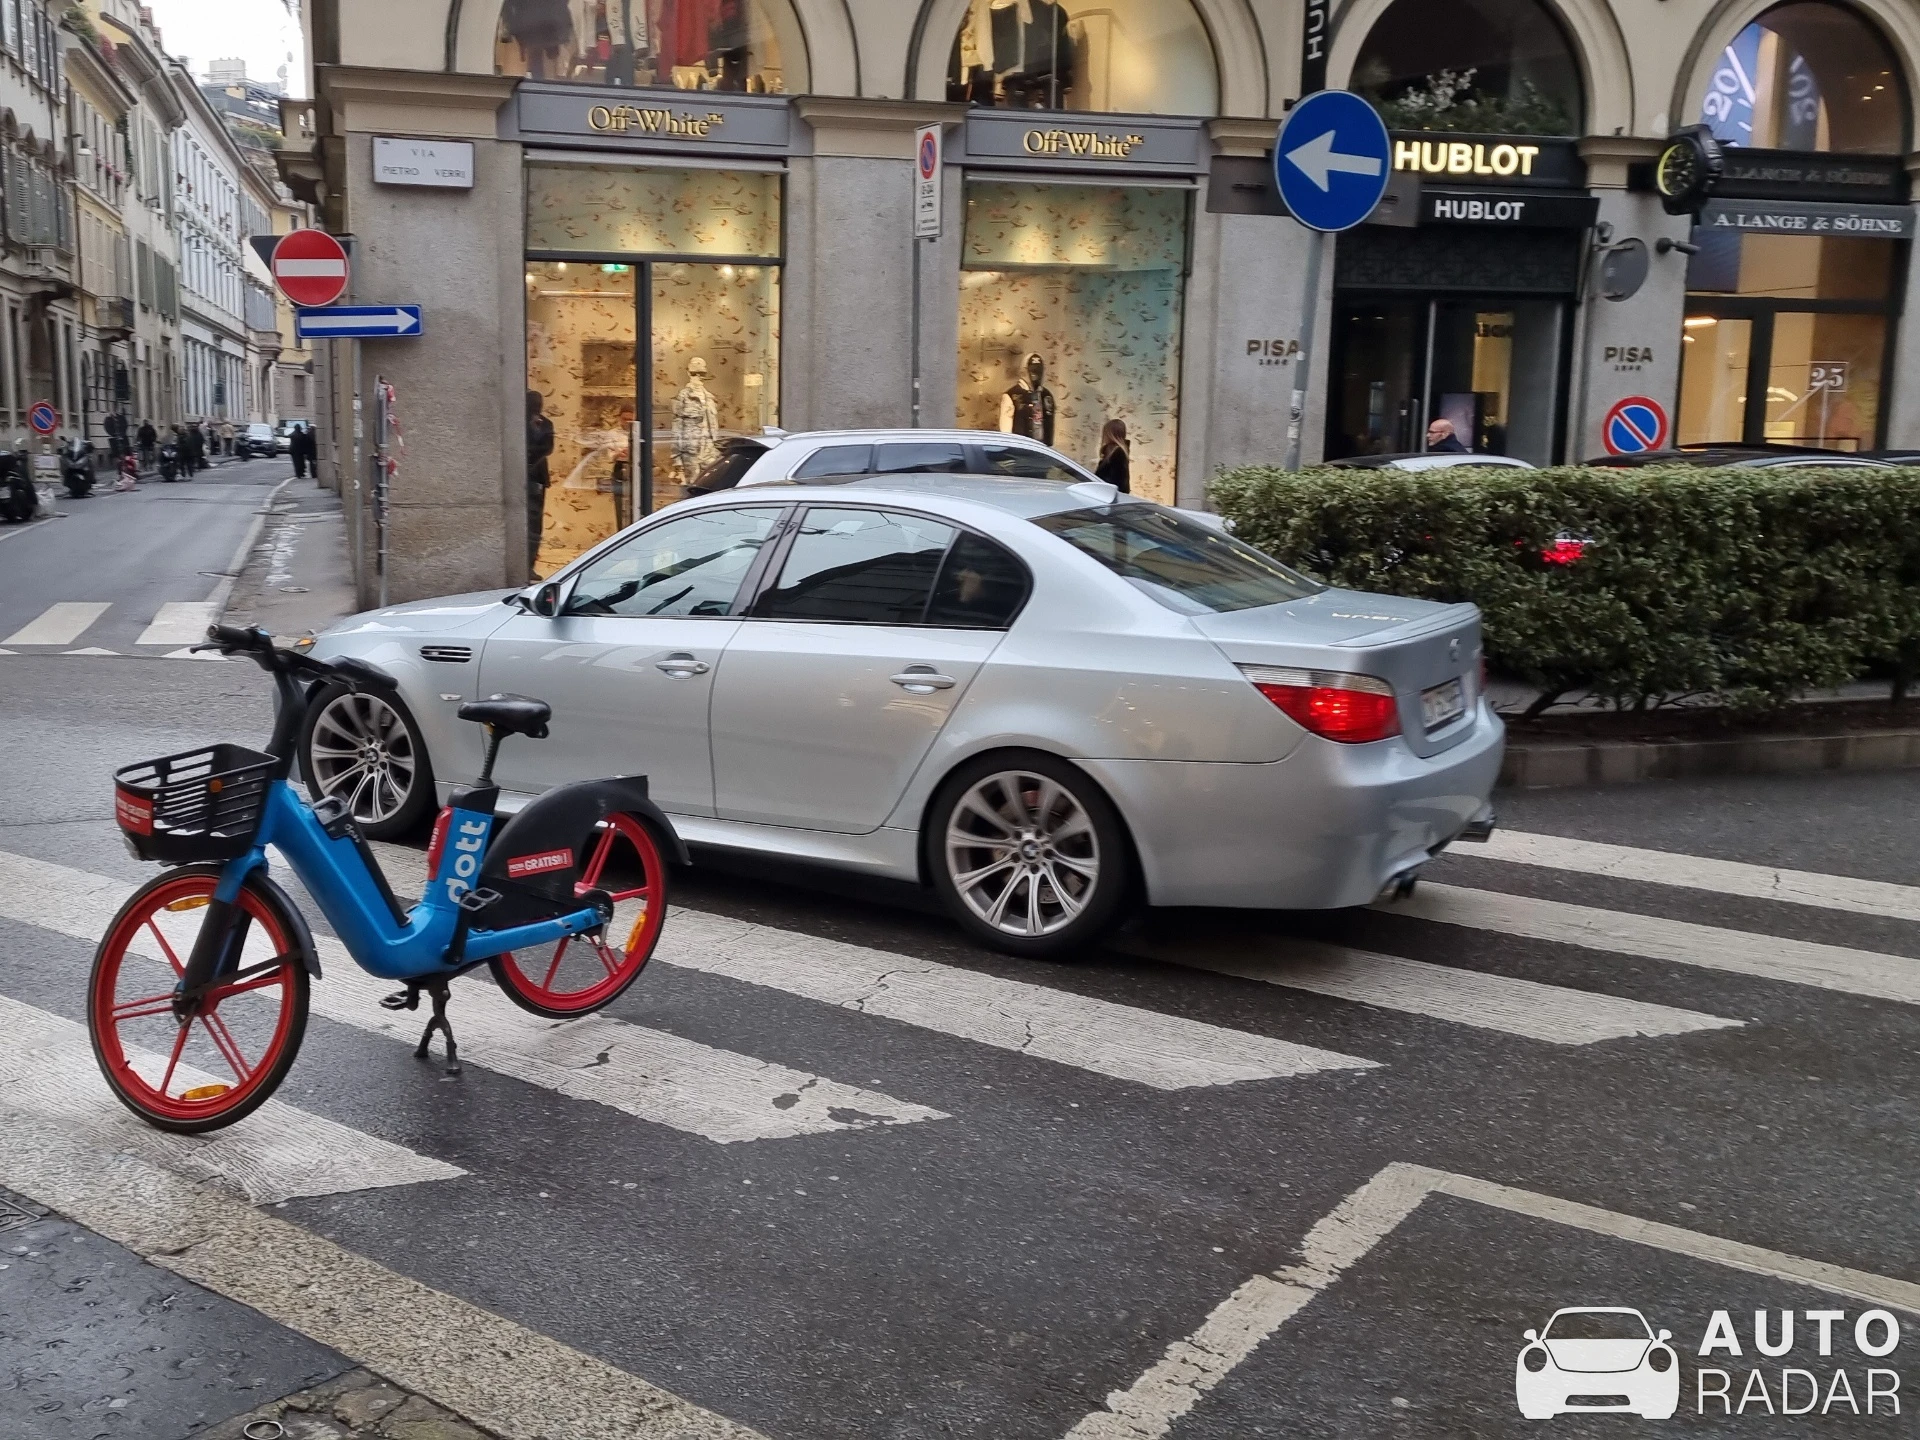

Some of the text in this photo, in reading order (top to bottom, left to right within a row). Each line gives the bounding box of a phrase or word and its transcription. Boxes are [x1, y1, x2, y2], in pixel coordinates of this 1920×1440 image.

[1307, 0, 1324, 60] HU
[410, 148, 436, 158] VIA
[1394, 140, 1540, 176] HUBLOT
[1434, 199, 1526, 221] HUBLOT
[1811, 216, 1830, 231] &
[1833, 214, 1903, 233] SÖHNE
[1246, 339, 1299, 356] PISA
[1603, 346, 1654, 362] PISA
[1810, 367, 1845, 387] 25
[446, 820, 487, 904] dott
